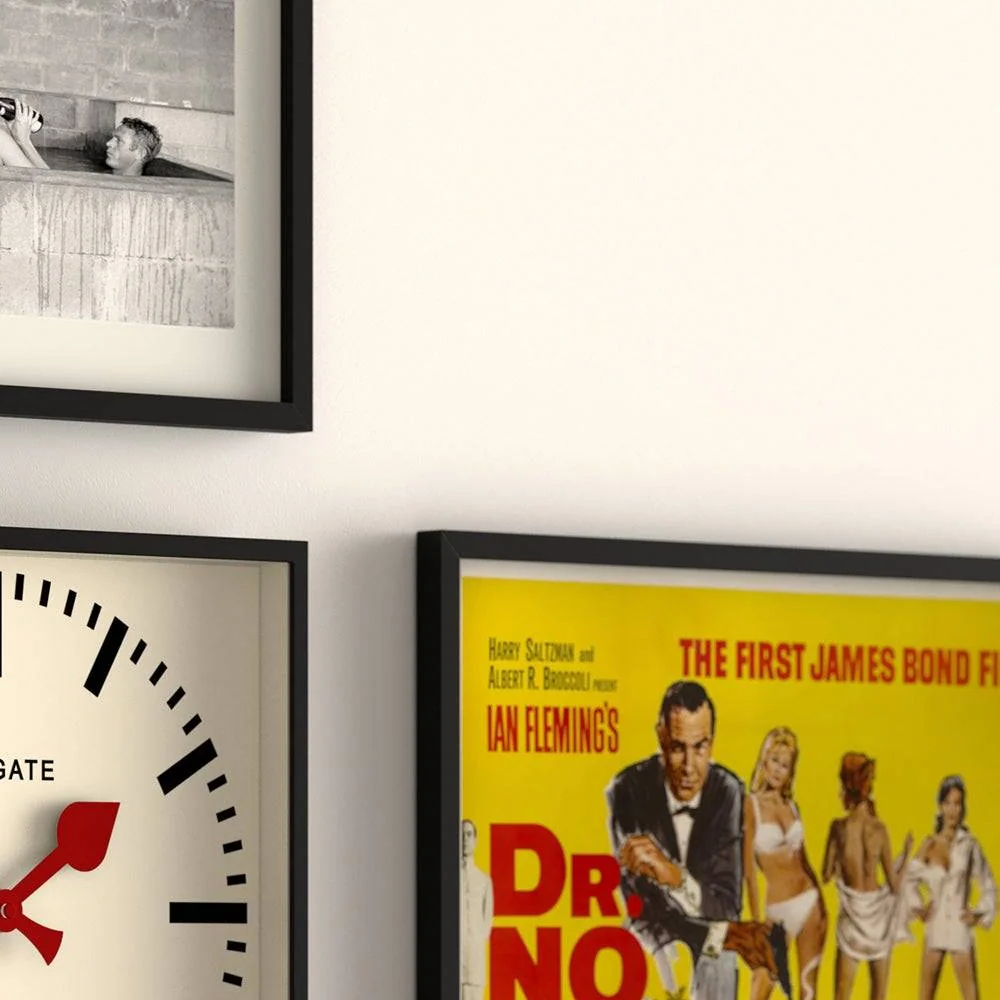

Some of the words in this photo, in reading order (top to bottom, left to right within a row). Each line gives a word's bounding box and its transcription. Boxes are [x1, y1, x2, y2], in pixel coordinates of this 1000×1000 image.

[488, 637, 520, 661] HARRY
[525, 637, 575, 663] SALTZMAN
[579, 646, 595, 662] and
[678, 638, 727, 678] THE
[735, 640, 806, 681] FIRST
[809, 643, 896, 684] JAMES
[902, 647, 970, 687] BOND
[488, 665, 525, 690] ALBERT
[527, 667, 540, 690] R.
[543, 666, 590, 692] BROCCOLI
[487, 704, 519, 753] IAN
[524, 701, 620, 753] FLEMING'S
[490, 823, 643, 918] DR.
